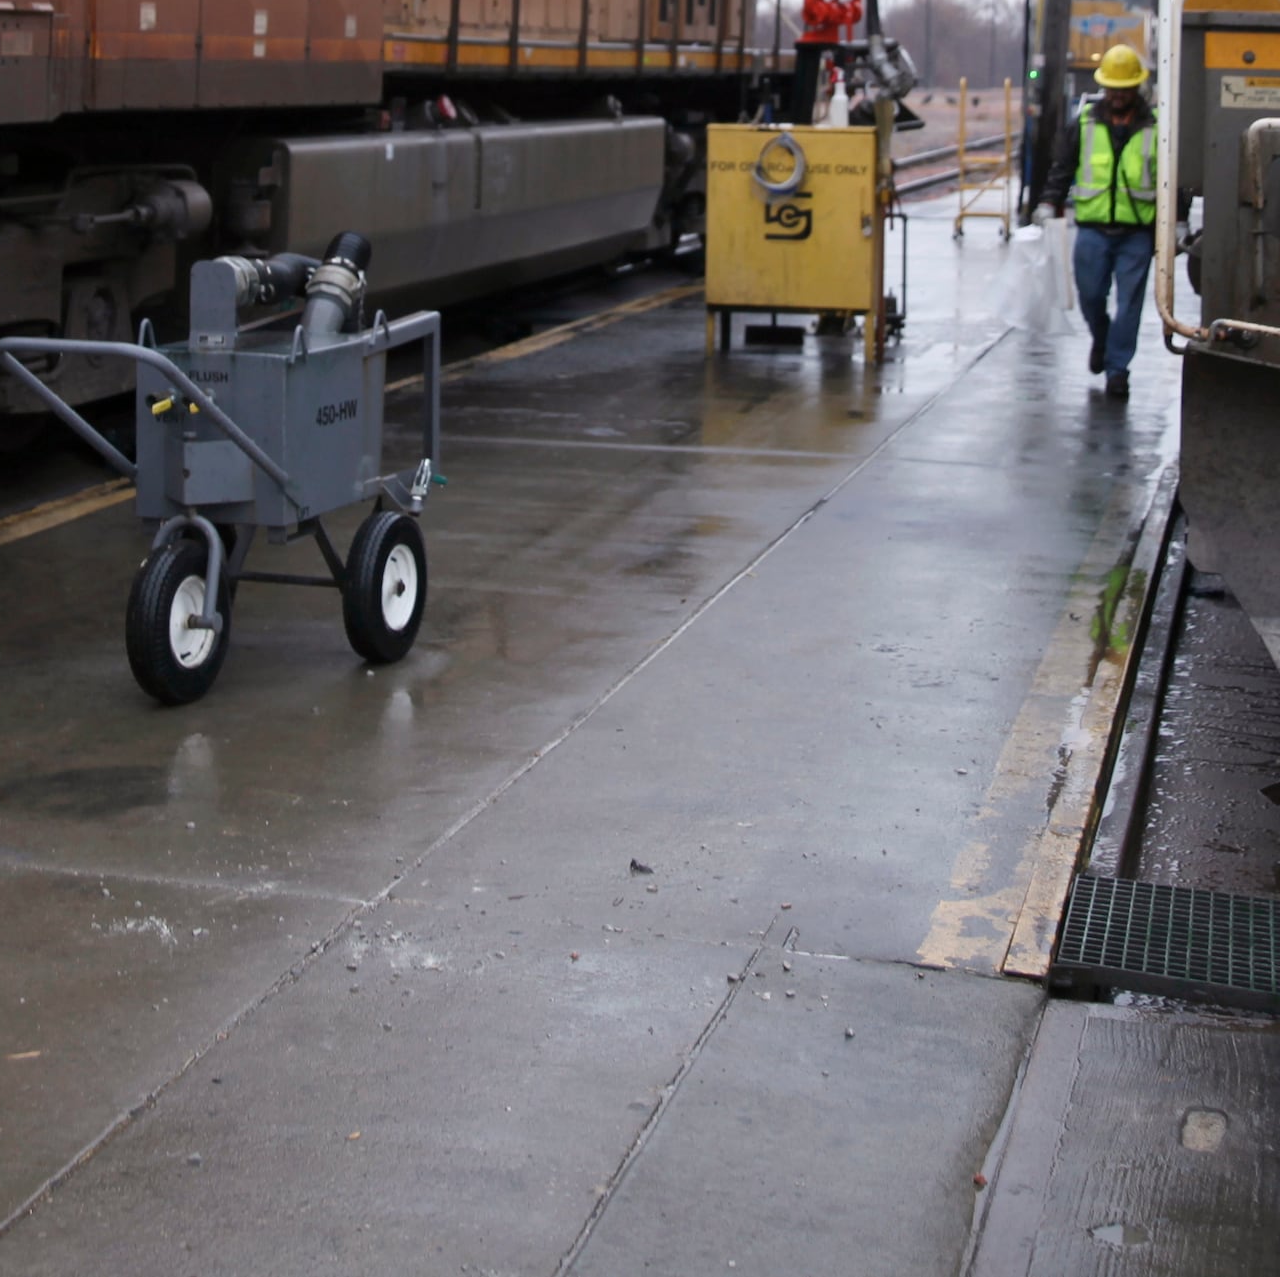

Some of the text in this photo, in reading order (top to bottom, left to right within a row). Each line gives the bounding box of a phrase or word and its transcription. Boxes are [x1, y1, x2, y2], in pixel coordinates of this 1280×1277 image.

[710, 160, 736, 171] FOR
[835, 162, 868, 174] ONLY
[316, 398, 358, 426] 450-HW
